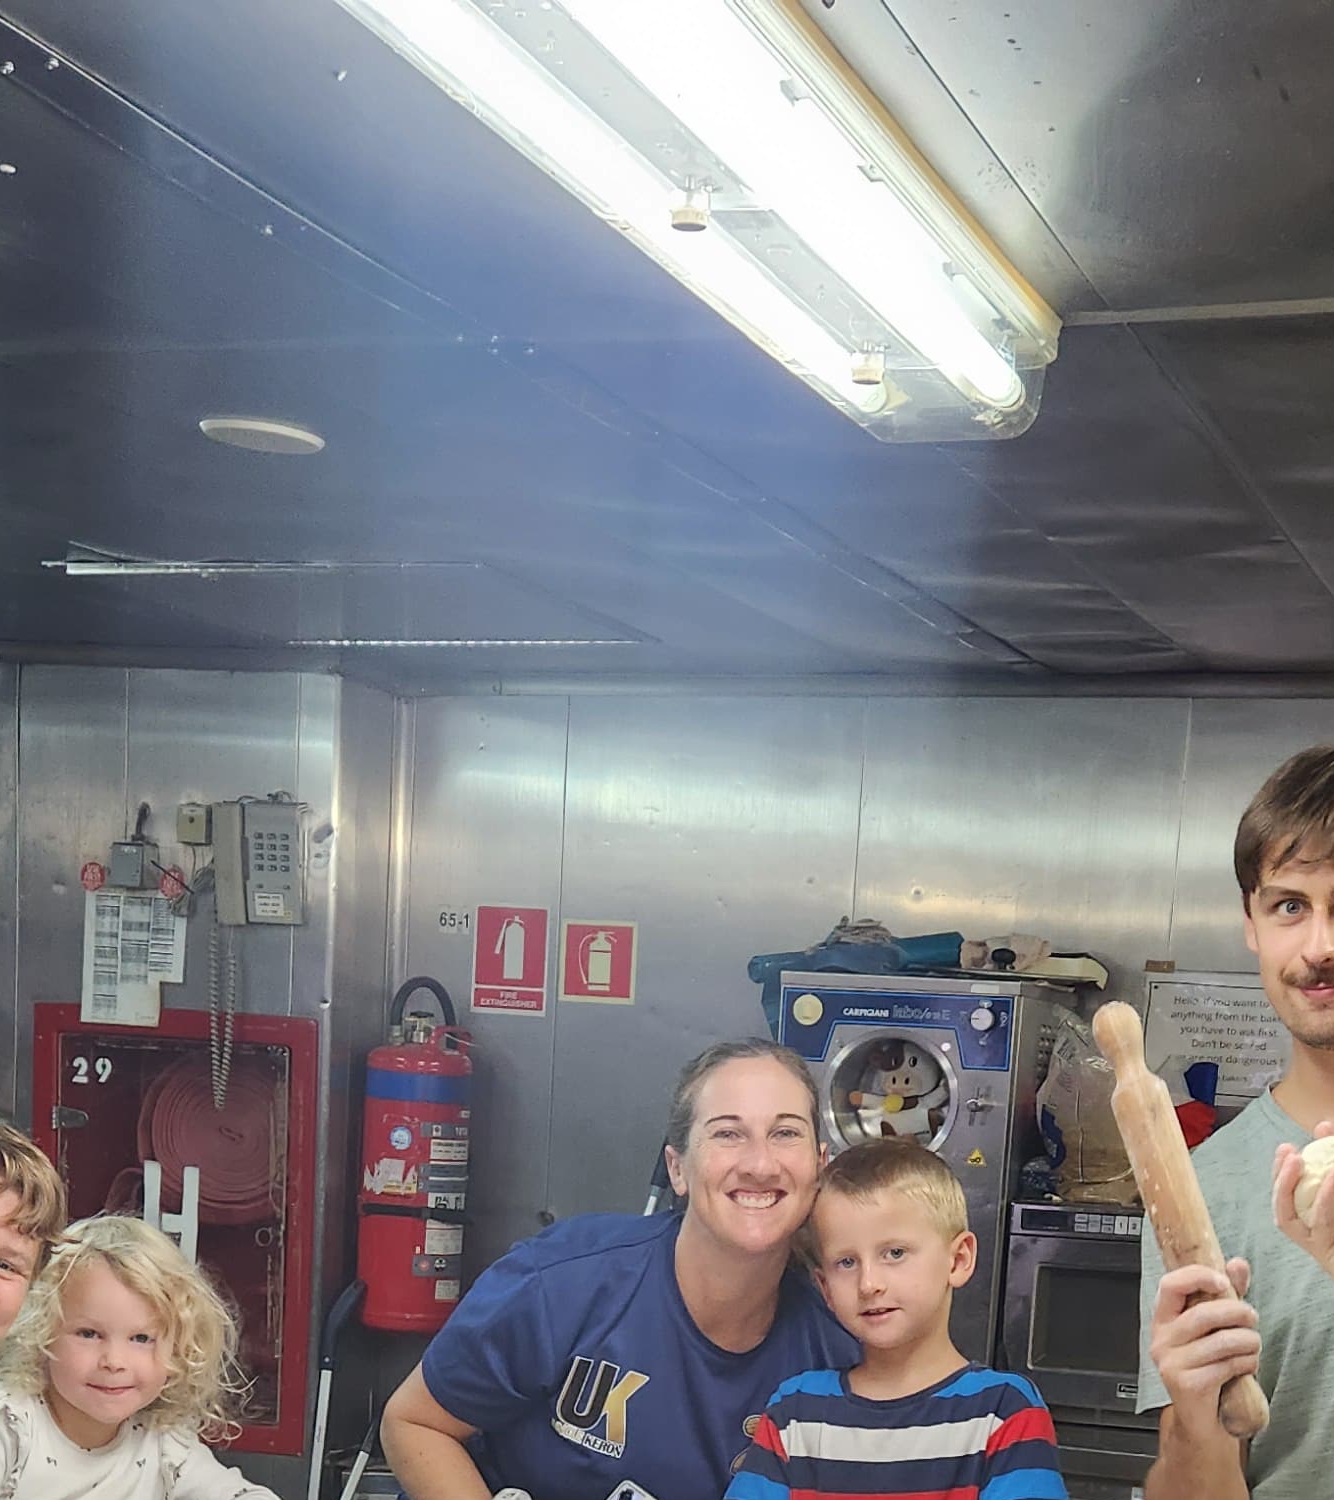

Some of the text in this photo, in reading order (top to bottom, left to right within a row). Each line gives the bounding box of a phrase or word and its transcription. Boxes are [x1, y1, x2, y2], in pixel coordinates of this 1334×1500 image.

[439, 912, 469, 928] 65-1
[500, 991, 518, 999] FIRE
[480, 998, 537, 1008] EXTINGUISHER
[1232, 1000, 1258, 1008] want
[1170, 1010, 1213, 1022] anything
[1215, 1011, 1240, 1021] from
[1241, 1012, 1258, 1022] the
[1180, 1026, 1199, 1035] you
[1201, 1026, 1224, 1035] have
[1226, 1027, 1237, 1036] to
[1239, 1028, 1255, 1037] ask
[1191, 1038, 1217, 1049] Don't
[1219, 1040, 1232, 1049] be
[72, 1056, 113, 1084] 29
[556, 1355, 650, 1446] UK
